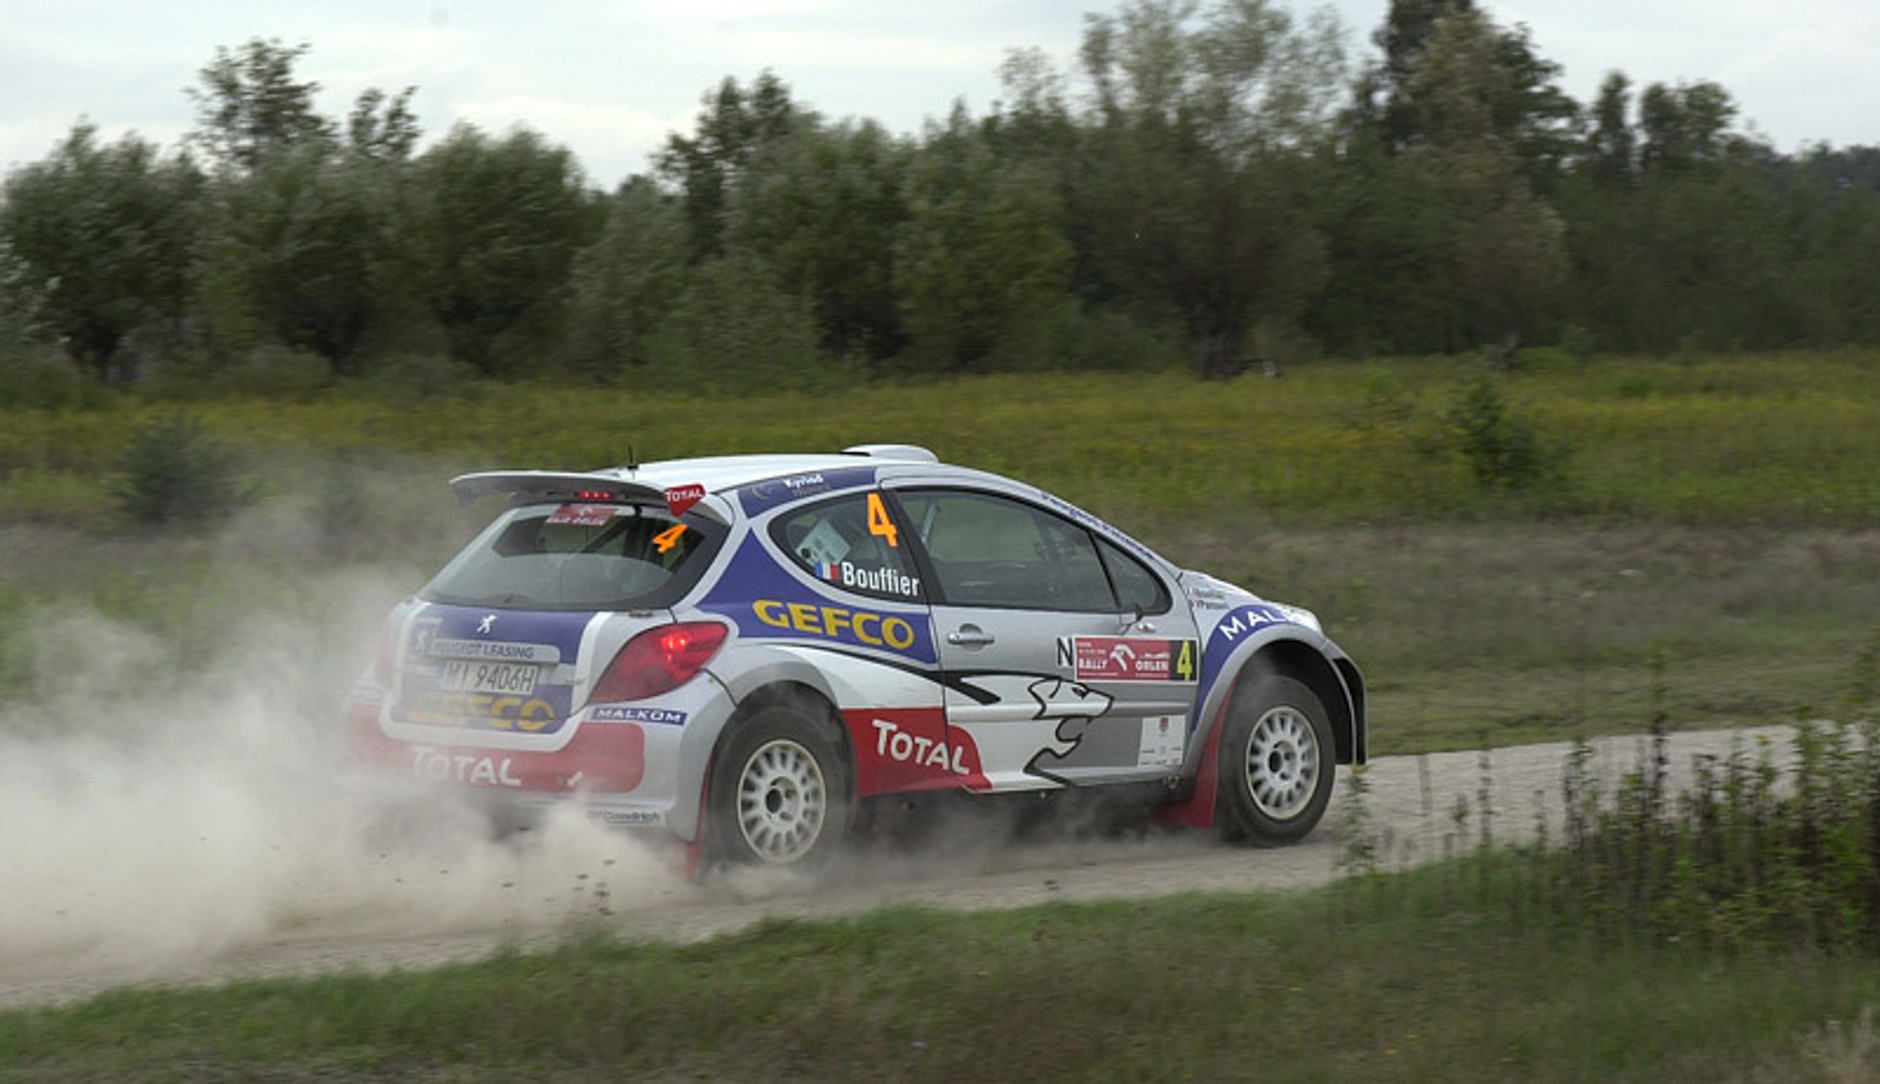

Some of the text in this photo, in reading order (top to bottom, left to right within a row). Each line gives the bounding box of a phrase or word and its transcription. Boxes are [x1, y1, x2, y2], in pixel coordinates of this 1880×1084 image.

[665, 489, 703, 502] TOTAL
[867, 493, 898, 547] 4
[652, 523, 688, 553] 4
[841, 561, 919, 596] Bouffier
[752, 599, 914, 649] GEFCO
[483, 644, 535, 659] LEASING
[1176, 640, 1193, 681] 4
[474, 664, 535, 693] 9406H
[597, 709, 681, 722] MALKOM
[872, 719, 970, 775] TOTAL
[413, 747, 522, 786] TOTAL
